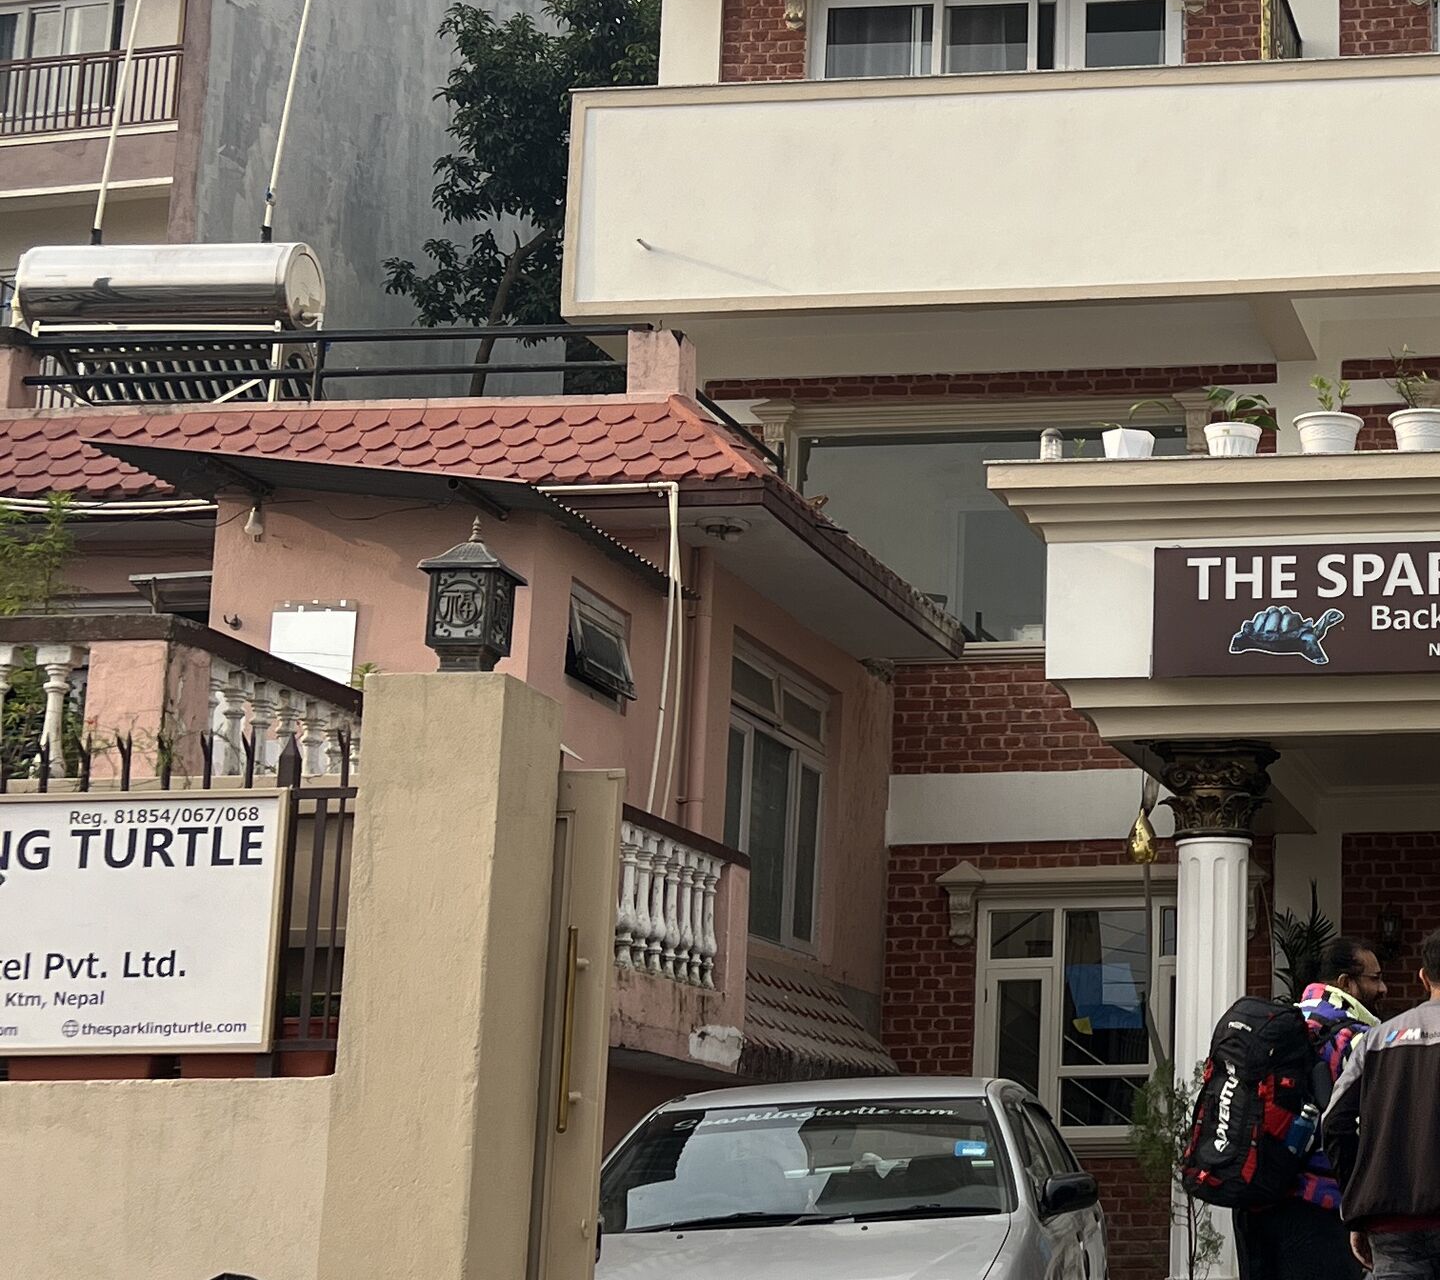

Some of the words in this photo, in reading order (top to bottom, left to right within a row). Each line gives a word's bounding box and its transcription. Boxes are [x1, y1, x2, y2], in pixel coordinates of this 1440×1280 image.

[1186, 556, 1298, 601] THE
[69, 811, 107, 828] Reg.
[114, 806, 259, 825] 81854/067/068
[70, 825, 265, 869] TURTLE
[0, 952, 31, 981] el
[44, 952, 107, 980] Pvt.
[123, 949, 186, 978] Ltd.
[5, 992, 47, 1009] Ktm,
[53, 990, 105, 1009] Nepal
[81, 1021, 247, 1037] thesparklingturtle.com
